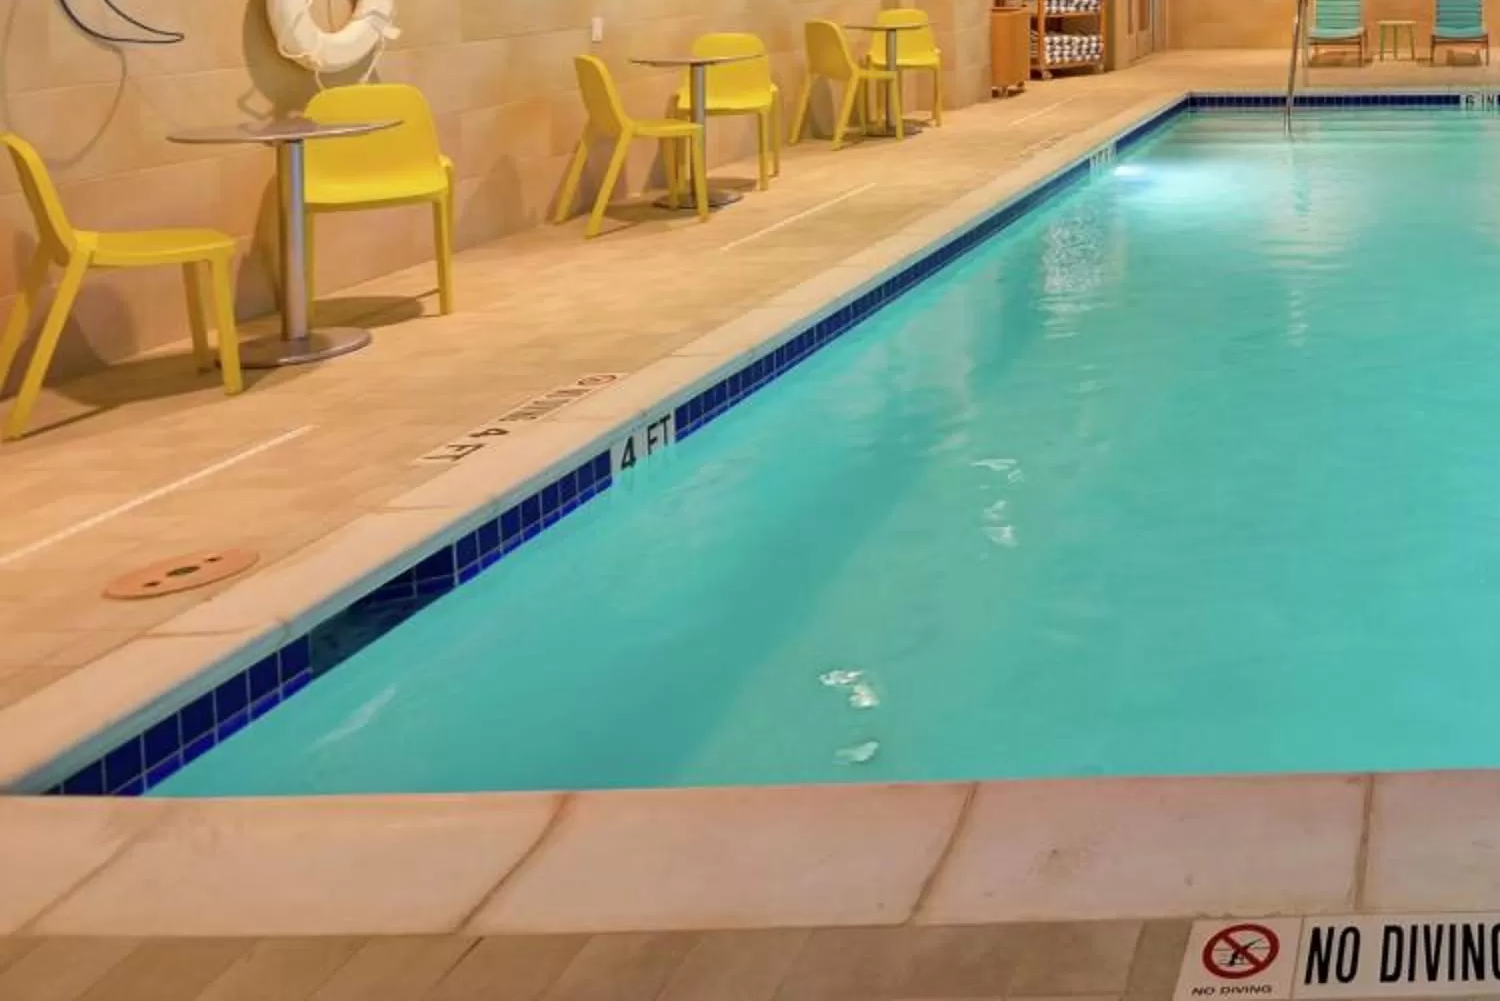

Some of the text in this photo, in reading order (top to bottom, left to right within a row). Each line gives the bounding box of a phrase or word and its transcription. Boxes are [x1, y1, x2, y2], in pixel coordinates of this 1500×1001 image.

[621, 414, 671, 471] 4 FT
[1304, 926, 1361, 985] NO
[1191, 984, 1272, 996] NO DIVING
